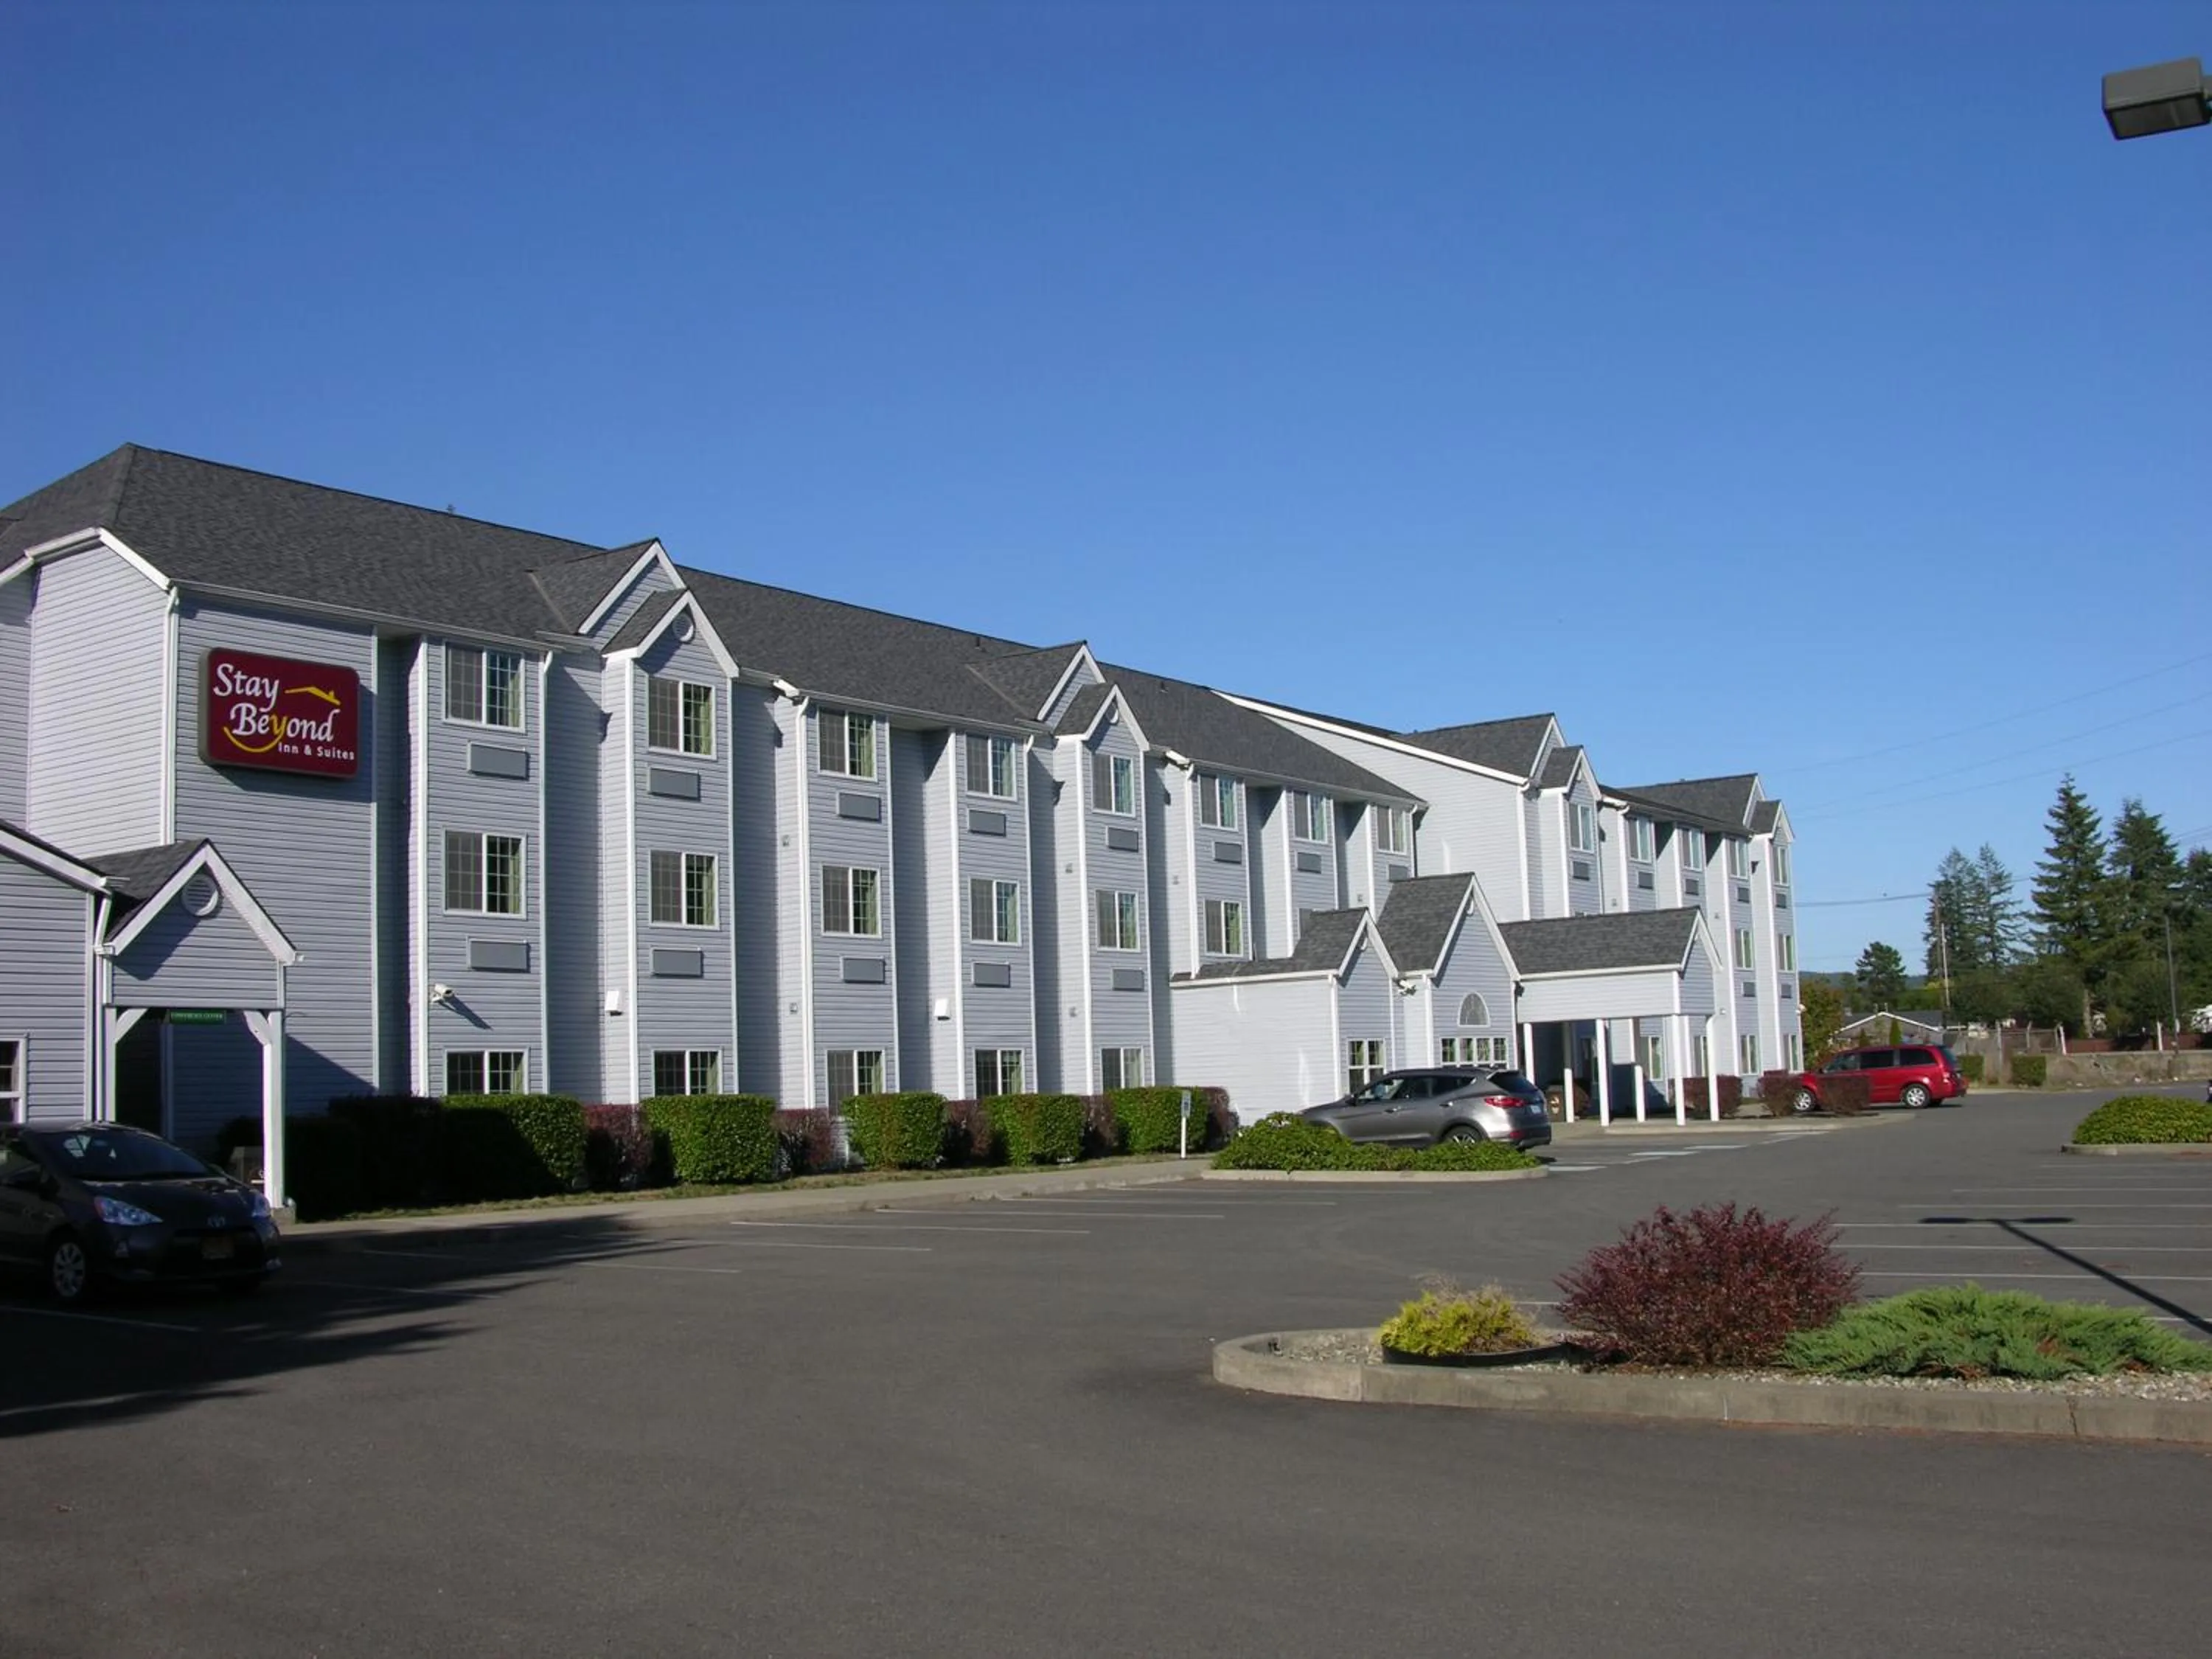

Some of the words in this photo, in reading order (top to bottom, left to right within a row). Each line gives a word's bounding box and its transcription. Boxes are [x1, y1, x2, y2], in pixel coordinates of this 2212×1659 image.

[213, 663, 279, 712] Stay
[227, 702, 341, 746] Beyond
[277, 742, 299, 754] Inn
[304, 745, 313, 757] &
[316, 746, 355, 761] Suites
